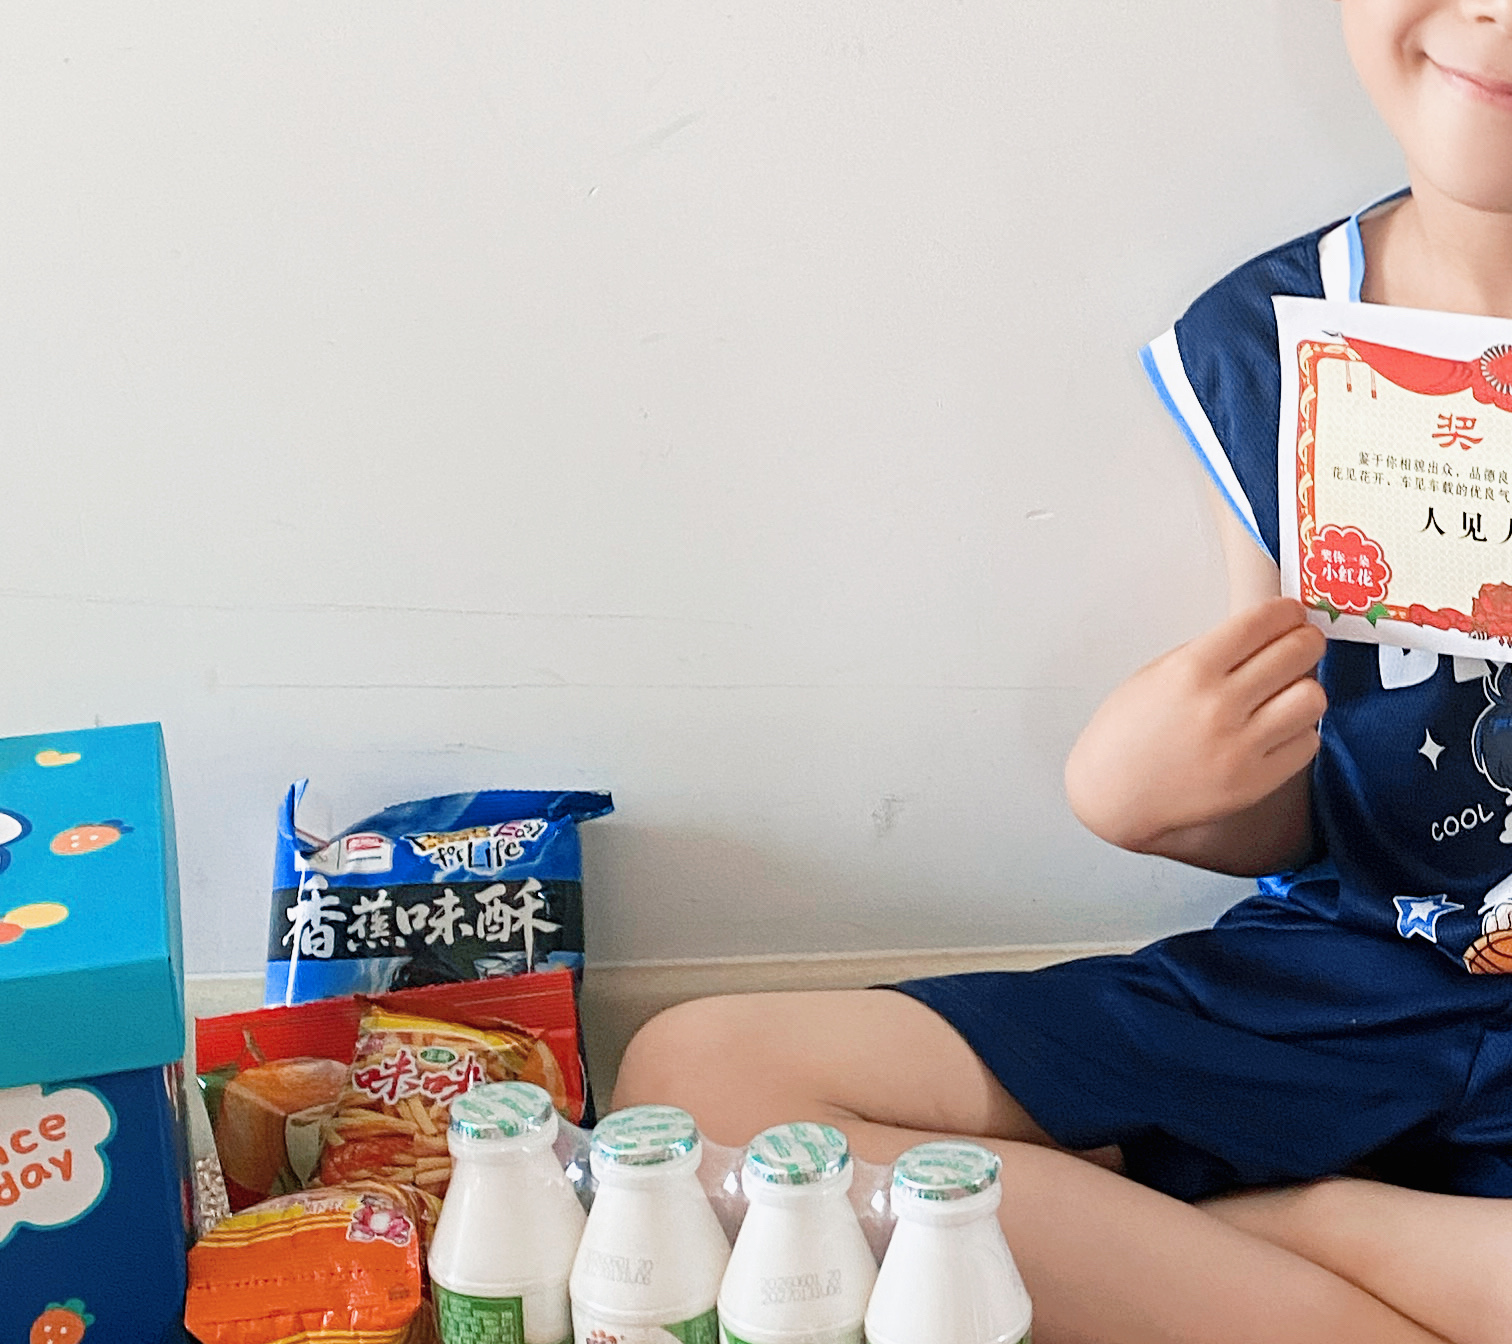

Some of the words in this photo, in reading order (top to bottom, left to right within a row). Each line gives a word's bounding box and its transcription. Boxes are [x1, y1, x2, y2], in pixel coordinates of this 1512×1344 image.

[1430, 806, 1495, 842] COOL
[282, 874, 564, 962] 香蕉味酥
[0, 1113, 67, 1166] ce
